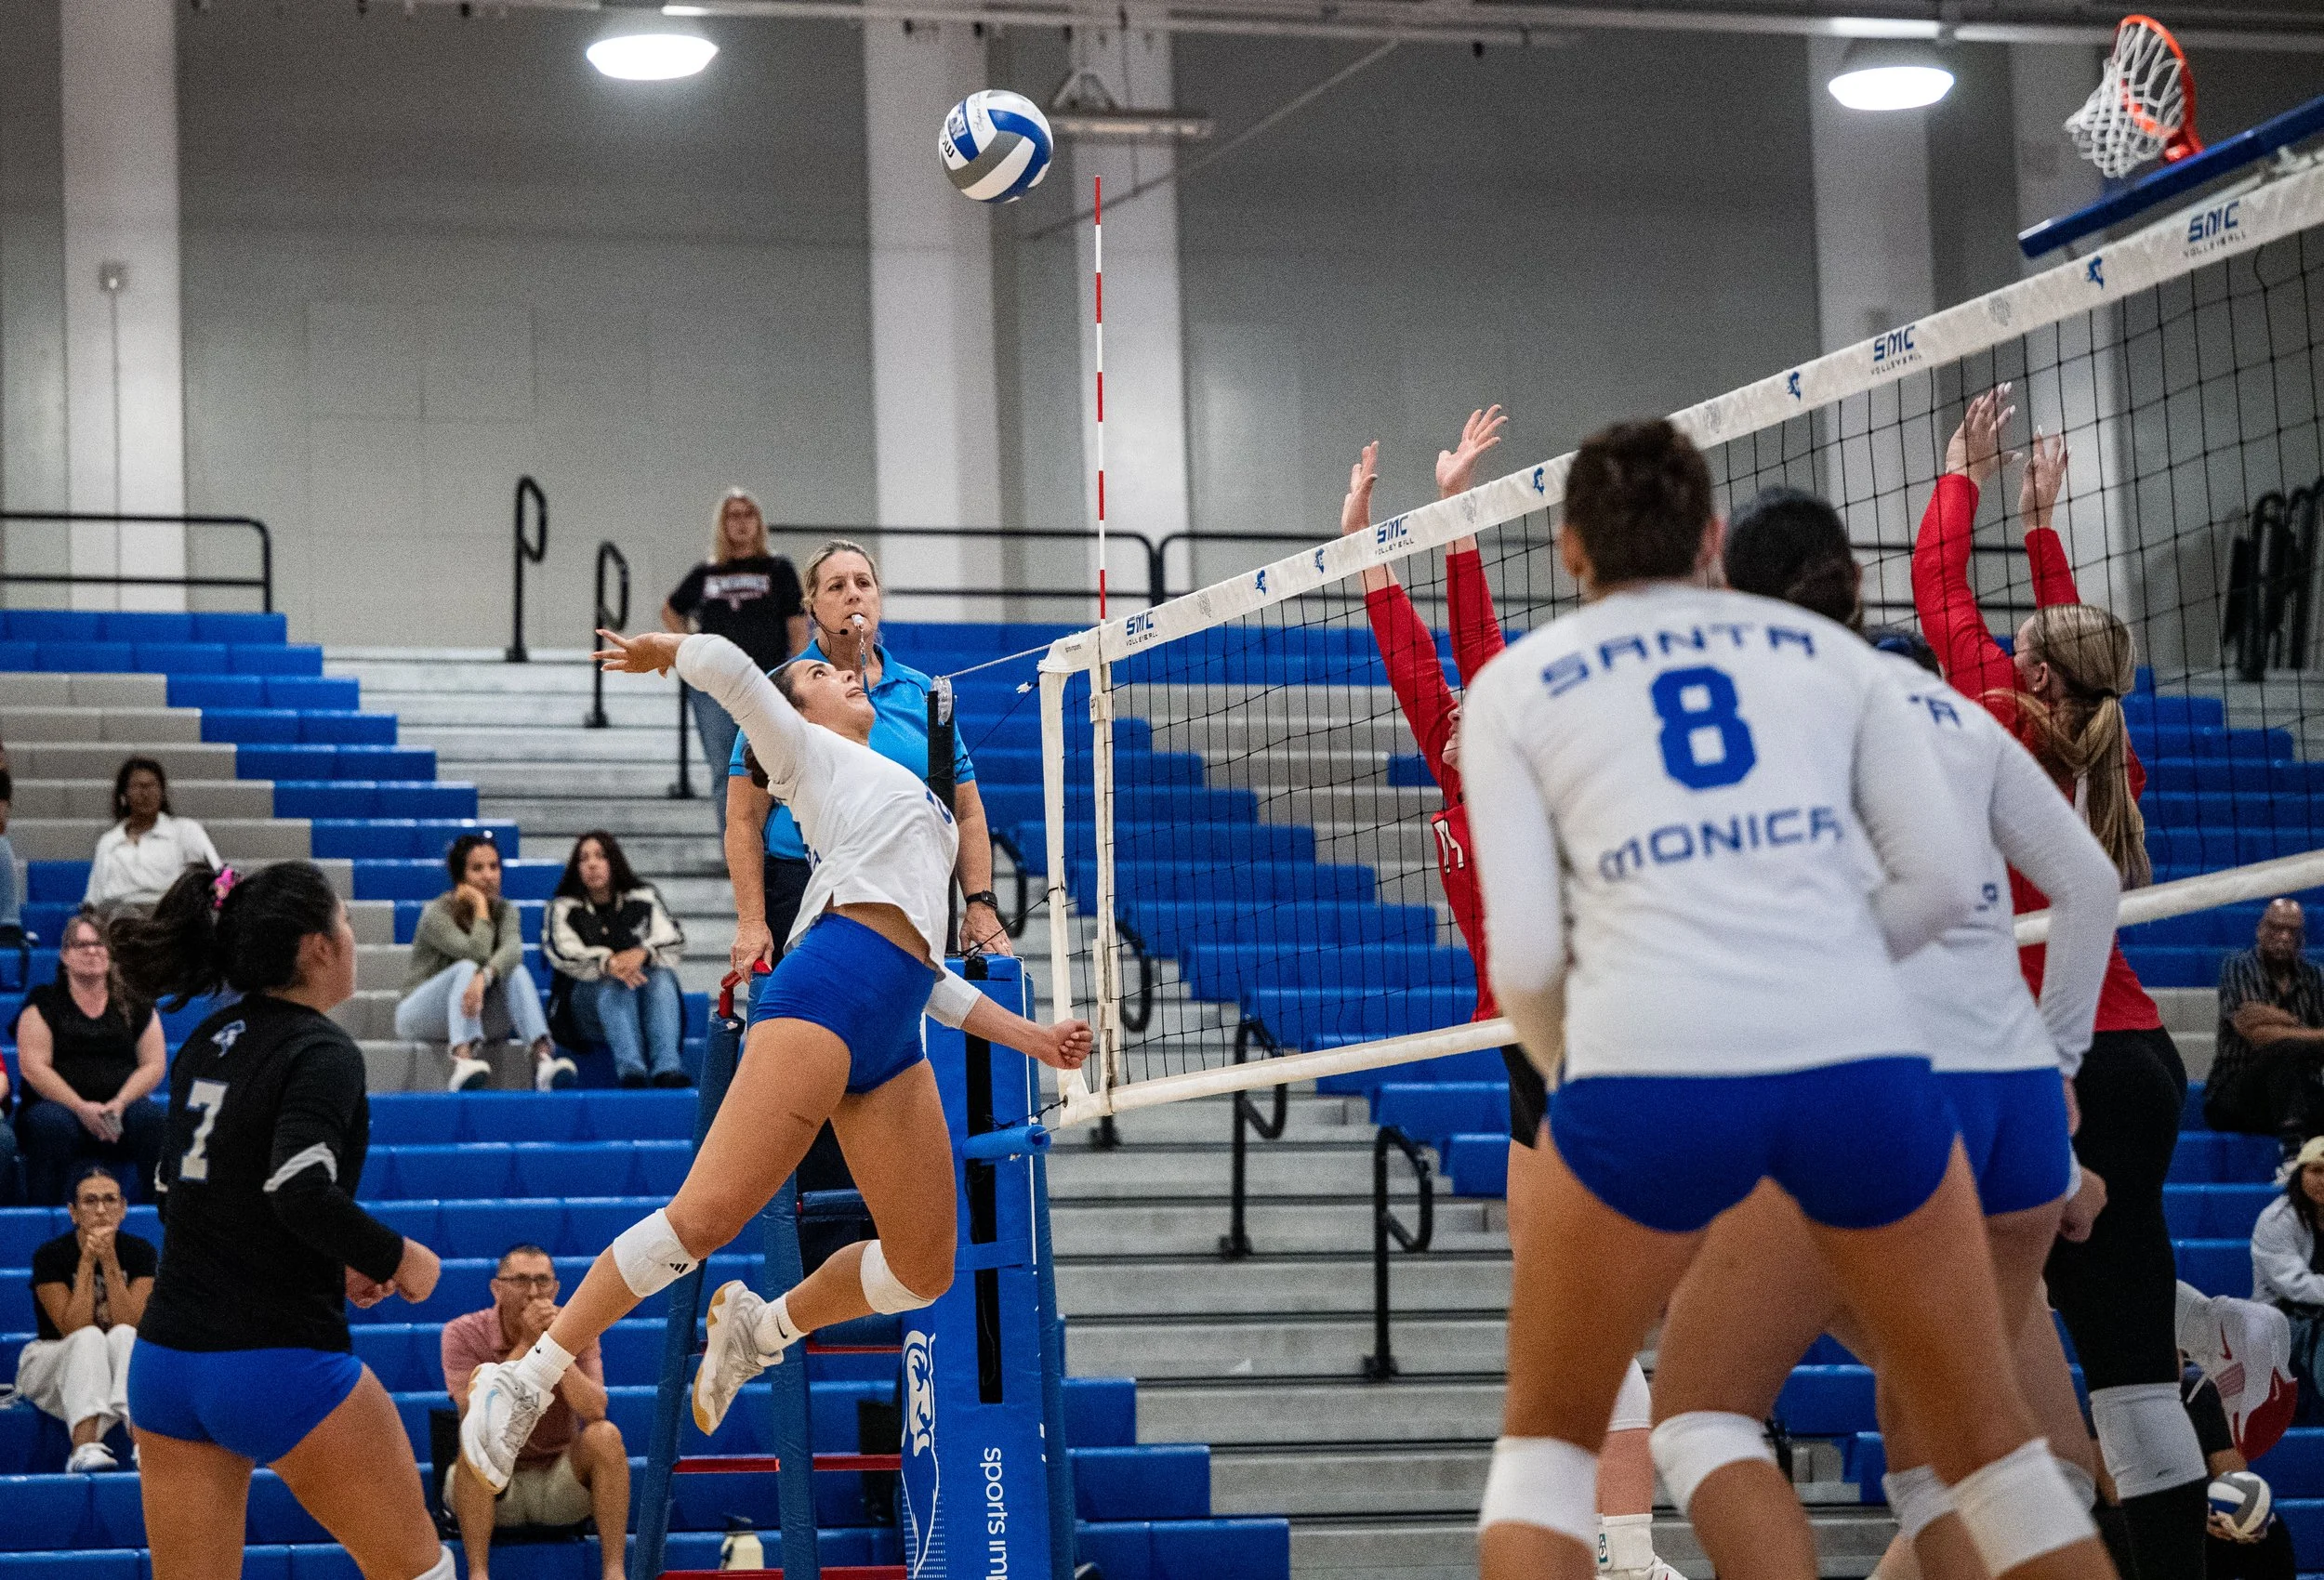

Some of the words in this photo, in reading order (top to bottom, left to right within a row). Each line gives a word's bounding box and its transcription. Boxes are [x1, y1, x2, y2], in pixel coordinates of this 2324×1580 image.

[2188, 201, 2239, 243] SMC
[1873, 325, 1915, 362] SMC
[1377, 514, 1409, 545] SMC
[1126, 612, 1155, 637] SMC
[1541, 621, 1816, 698] SANTA
[1649, 665, 1757, 792] 8
[1598, 805, 1845, 883] MONICA
[179, 1078, 231, 1183] 7
[979, 1447, 1009, 1535] sports
